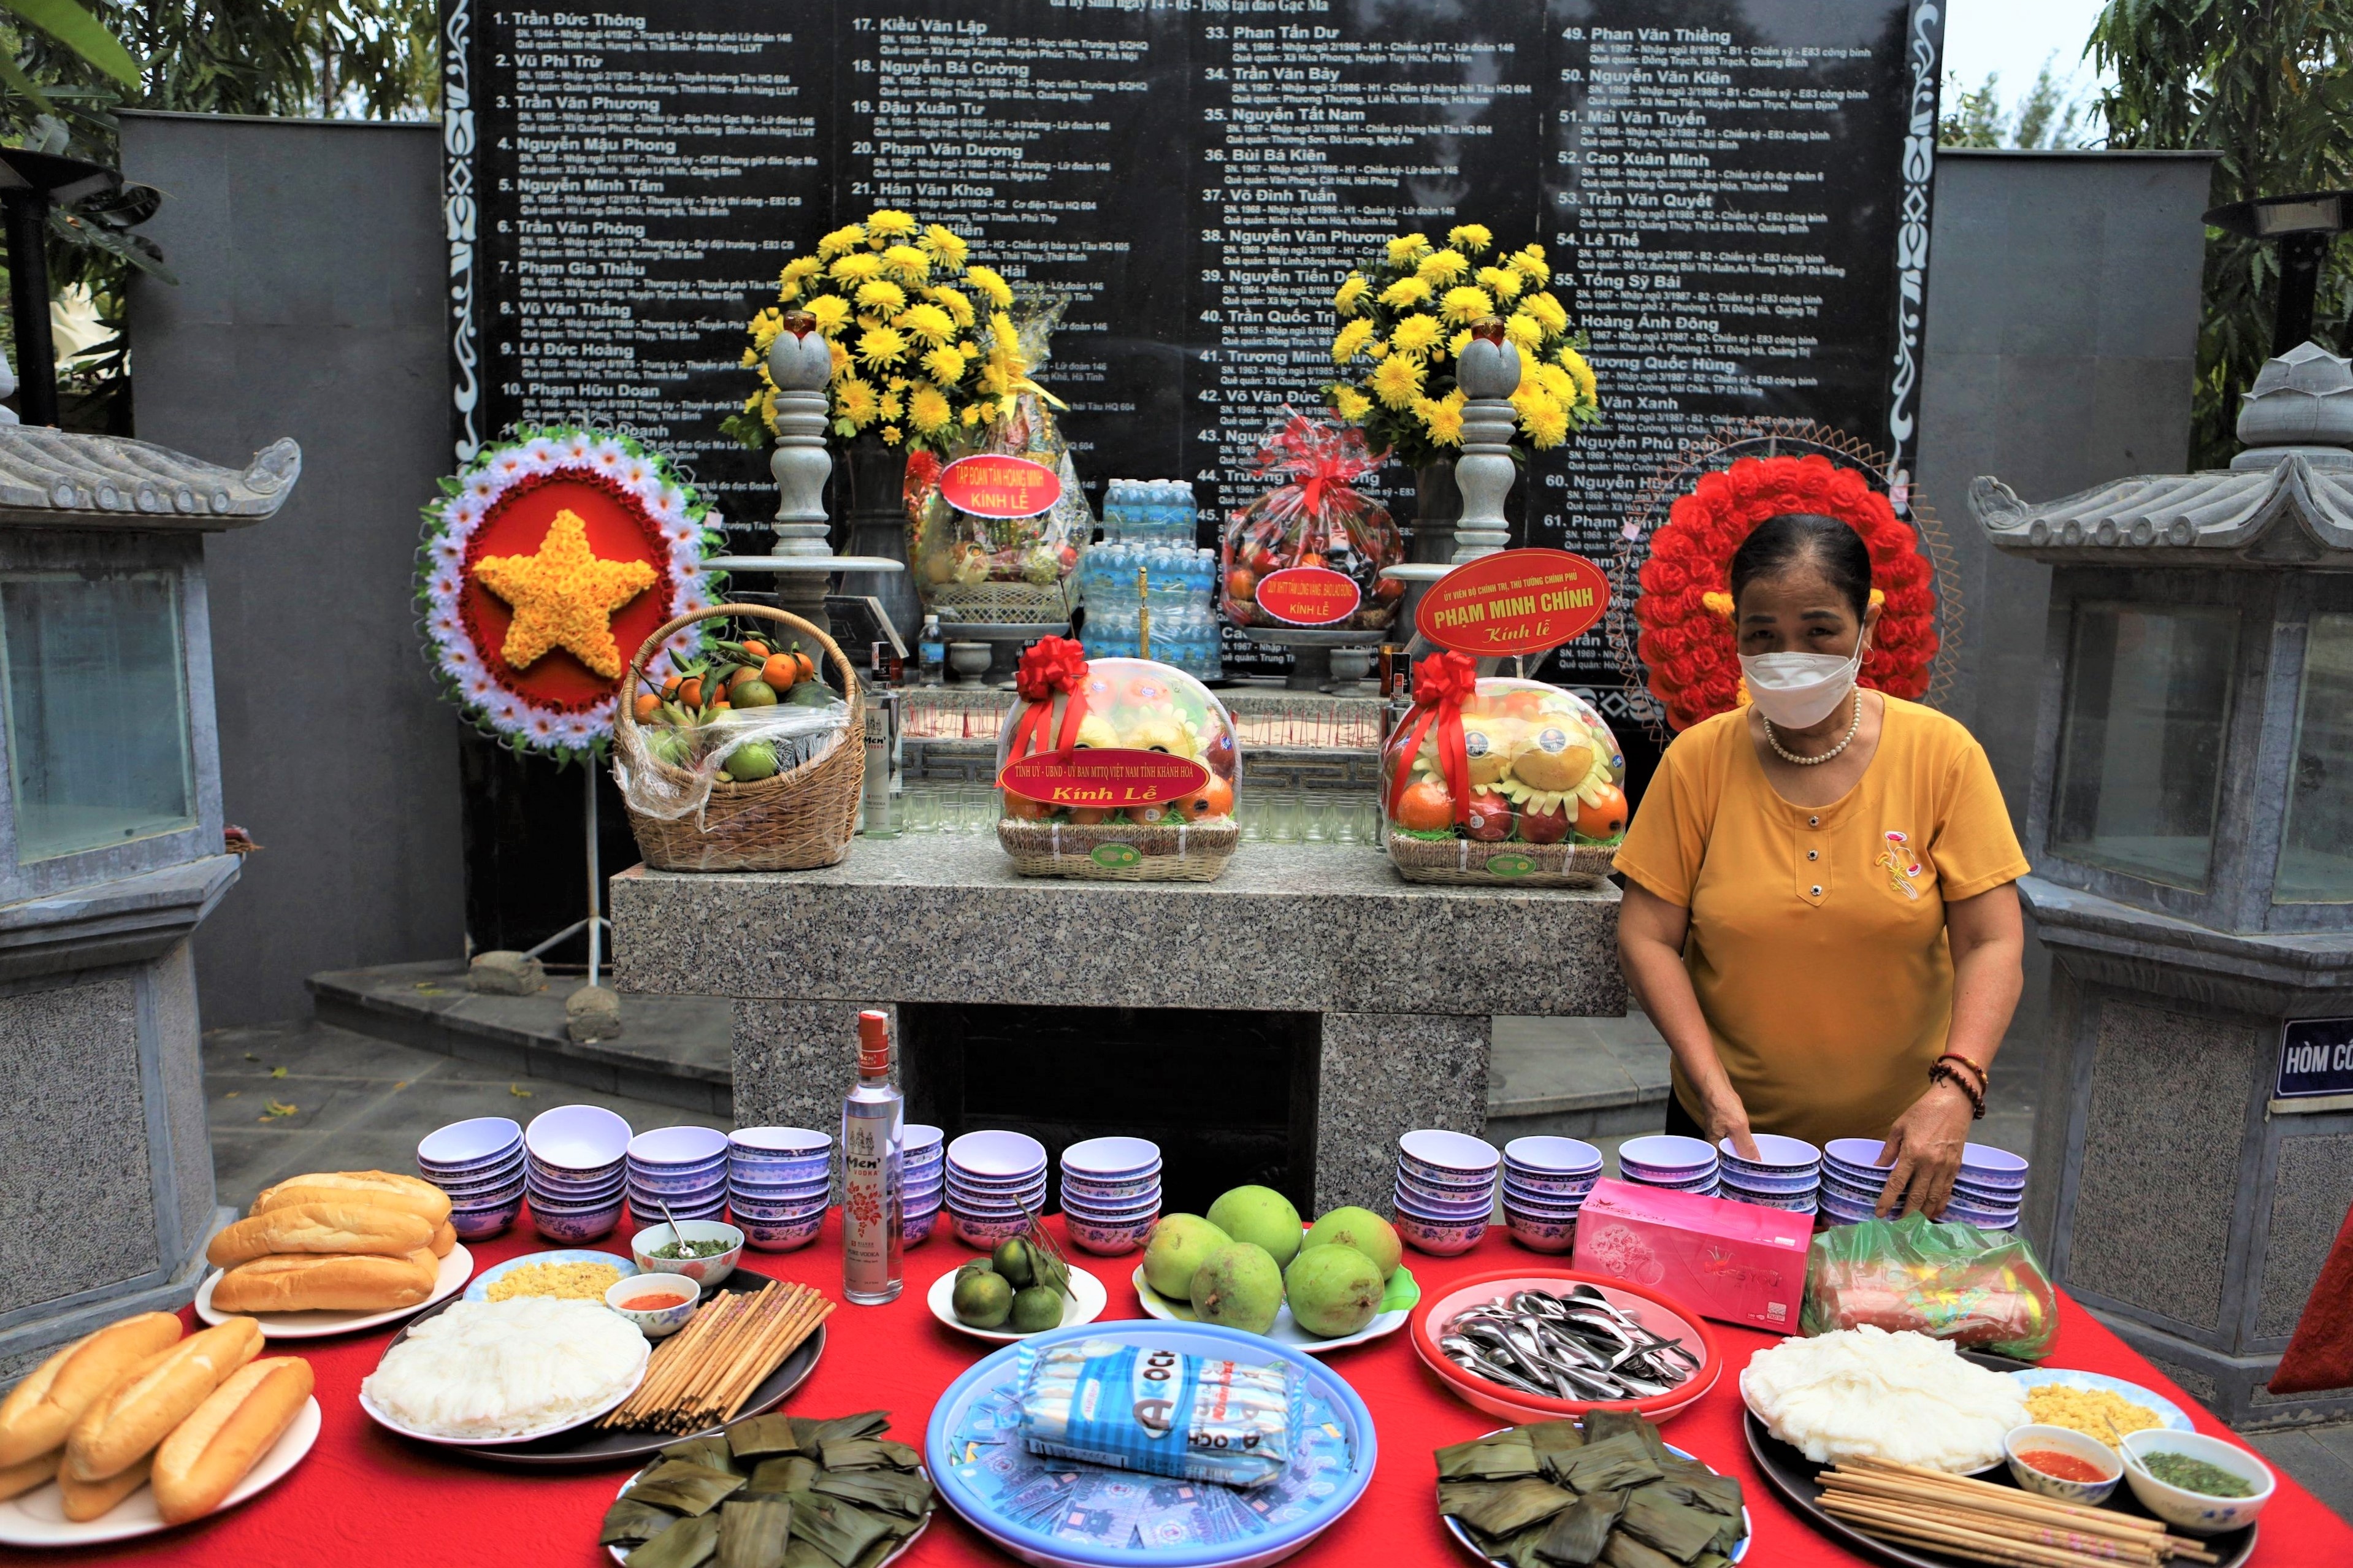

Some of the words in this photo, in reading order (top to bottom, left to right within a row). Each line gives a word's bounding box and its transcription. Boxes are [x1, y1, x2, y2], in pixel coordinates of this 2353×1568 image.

[1201, 1, 1228, 11] 1988
[494, 12, 508, 25] 1.
[511, 10, 549, 25] Trần
[553, 12, 589, 26] Đức
[592, 13, 646, 29] Thông
[852, 18, 876, 31] 17.
[880, 16, 917, 31] Kiều
[921, 19, 952, 31] Văn
[957, 20, 987, 35] Lập
[1205, 26, 1229, 39] 33.
[1234, 26, 1275, 39] Phan
[1279, 23, 1310, 39] Tấn
[1314, 26, 1340, 39] Dư
[1562, 28, 1586, 40] 49.
[1591, 28, 1633, 40] Phan
[1637, 28, 1669, 40] Văn
[1204, 109, 1228, 121] 35.
[1233, 106, 1294, 123] Nguyễn
[1298, 105, 1325, 121] Tất
[1328, 109, 1366, 121] Nam
[498, 178, 513, 191] 5.
[518, 176, 581, 194] Nguyễn
[584, 178, 624, 191] Minh
[627, 179, 664, 192] Tâm
[1202, 189, 1226, 202] 37.
[1230, 189, 1252, 202] Võ
[1255, 189, 1294, 202] Đình
[1298, 187, 1337, 202] Tuấn
[1558, 193, 1581, 204] 53.
[1586, 190, 1623, 205] Trần
[1627, 193, 1658, 205] Văn
[1663, 192, 1713, 208] Quyết
[1556, 232, 1579, 245] 54.
[1585, 233, 1604, 245] Lê
[1609, 231, 1640, 246] Thế
[499, 261, 513, 273] 7.
[518, 261, 564, 277] Phạm
[568, 262, 596, 275] Gia
[1555, 273, 1578, 286] 55.
[1583, 272, 1624, 289] Tống
[1629, 275, 1650, 289] Sỹ
[1654, 276, 1681, 288] Bái
[1199, 310, 1223, 322] 40.
[1228, 307, 1263, 323] Trần
[1268, 308, 1311, 323] Quốc
[1315, 310, 1335, 326] Trị
[1580, 315, 1634, 330] Hoàng
[1637, 313, 1670, 328] Ánh
[1675, 316, 1719, 332] Đông
[1198, 390, 1221, 402] 42.
[1226, 389, 1248, 402] Võ
[1252, 390, 1283, 402] Văn
[1287, 389, 1321, 403] Đức
[1602, 397, 1632, 408] Văn
[1637, 397, 1678, 410] Xanh
[1027, 469, 1044, 487] MINH
[971, 489, 1006, 508] KÍNH
[1011, 488, 1029, 510] LỄ
[1453, 587, 1467, 599] VIÊN
[1469, 587, 1477, 598] BỘ
[1478, 583, 1497, 595] CHÍNH
[1510, 576, 1522, 589] THỦ
[1523, 575, 1544, 588] TƯỚNG
[1545, 573, 1564, 585] CHÍNH
[1565, 568, 1578, 581] PHỦ
[1290, 602, 1314, 614] KÍNH
[1317, 601, 1329, 616] LỄ
[1434, 603, 1485, 629] PHẠM
[1488, 595, 1536, 620] MINH
[1540, 586, 1594, 613] CHÍNH
[1482, 622, 1531, 644] Kính
[1536, 618, 1551, 637] lễ
[1045, 765, 1063, 778] UBND
[1077, 765, 1090, 778] BAN
[1091, 765, 1109, 781] MTTQ
[1109, 762, 1124, 781] VIỆT
[1125, 765, 1139, 778] NAM
[1157, 762, 1179, 778] KHÁNH
[1052, 787, 1114, 800] Kính
[1123, 786, 1158, 800] Lễ
[2286, 1041, 2330, 1074] HÒM
